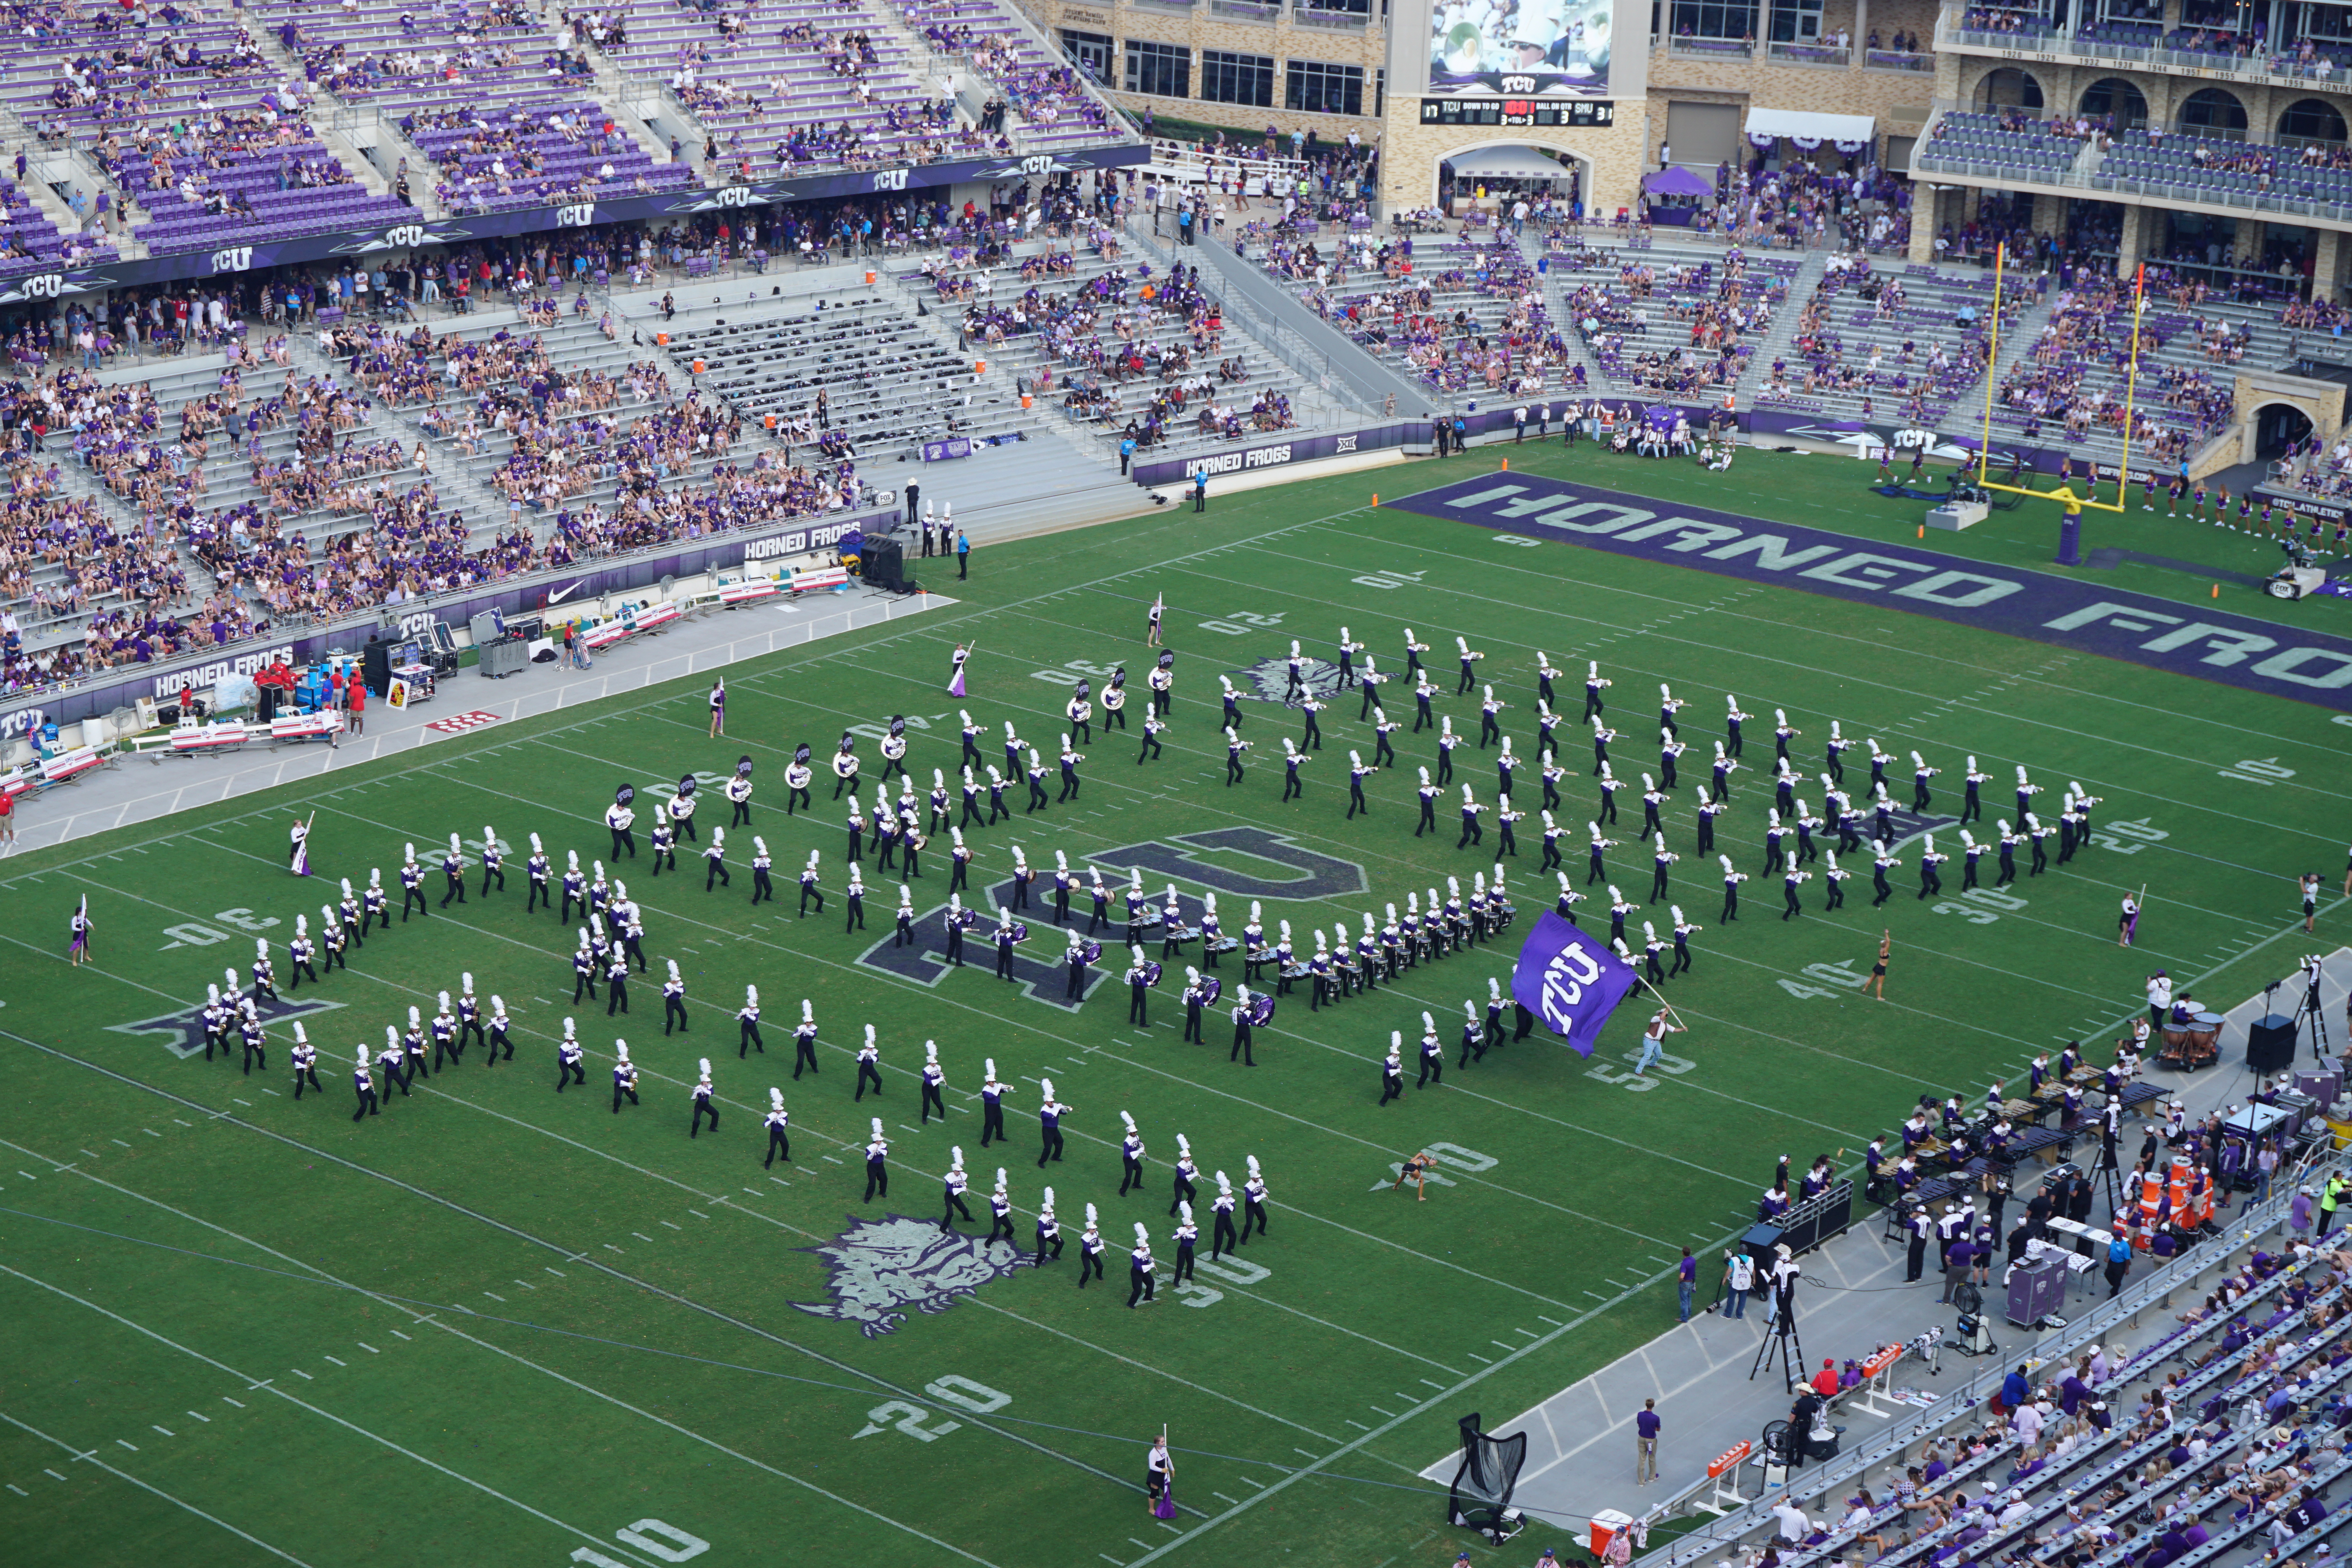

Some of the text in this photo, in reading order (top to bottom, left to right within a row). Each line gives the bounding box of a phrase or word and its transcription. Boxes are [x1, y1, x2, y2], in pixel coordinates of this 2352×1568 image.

[2002, 51, 2022, 59] 1920
[2036, 53, 2056, 62] 1929
[2080, 58, 2100, 66] 1932
[2113, 60, 2133, 69] 1938
[2148, 64, 2167, 73] 1944
[2181, 68, 2200, 76] 1951
[2215, 71, 2234, 80] 1955
[1502, 76, 1535, 93] TCU
[2249, 75, 2269, 84] 1958
[2284, 79, 2304, 88] 1959
[1426, 105, 1438, 117] 17
[1443, 102, 1460, 111] TCU
[1504, 100, 1535, 114] 10:01
[1575, 103, 1593, 113] SMU
[1597, 107, 1612, 120] 31
[1501, 115, 1507, 125] 3
[1527, 115, 1534, 125] 3
[1561, 111, 1568, 124] 3
[1021, 156, 1053, 176] TCU
[873, 169, 908, 191] TCU
[716, 188, 750, 208] TCU
[557, 204, 594, 227] TCU
[386, 226, 423, 248] TCU
[212, 247, 252, 272] TCU
[22, 275, 62, 299] TCU
[1187, 445, 1290, 477] HORNED FROGS
[746, 532, 806, 559] HORNED
[1352, 570, 1423, 589] 10
[1443, 485, 2352, 688] HORNED FRO
[399, 613, 435, 640] TCU
[1198, 611, 1282, 635] 20
[1160, 655, 1173, 664] TCU
[1031, 660, 1118, 685] 30
[1114, 673, 1125, 684] TCU
[1079, 684, 1089, 696] TCU
[1, 709, 43, 739] TCU
[892, 720, 904, 732] TCU
[844, 737, 853, 749] TCU
[796, 749, 809, 760] TCU
[739, 762, 752, 773] TCU
[2217, 760, 2296, 786] 10
[642, 771, 737, 799] 50
[680, 780, 695, 792] TCU
[617, 788, 633, 800] TCU
[2082, 820, 2170, 855] 20
[1931, 888, 2029, 924] 30
[163, 908, 281, 946] 30
[1542, 942, 1600, 1035] TCU
[1778, 963, 1860, 1002] 40
[1257, 1003, 1272, 1016] TCU
[1142, 1250, 1271, 1308] 30
[2246, 1332, 2254, 1342] 5
[1878, 1354, 1896, 1369] GATORADE
[867, 1375, 1012, 1442] 20
[1723, 1451, 1744, 1470] GATORADE
[2298, 1510, 2309, 1524] 5
